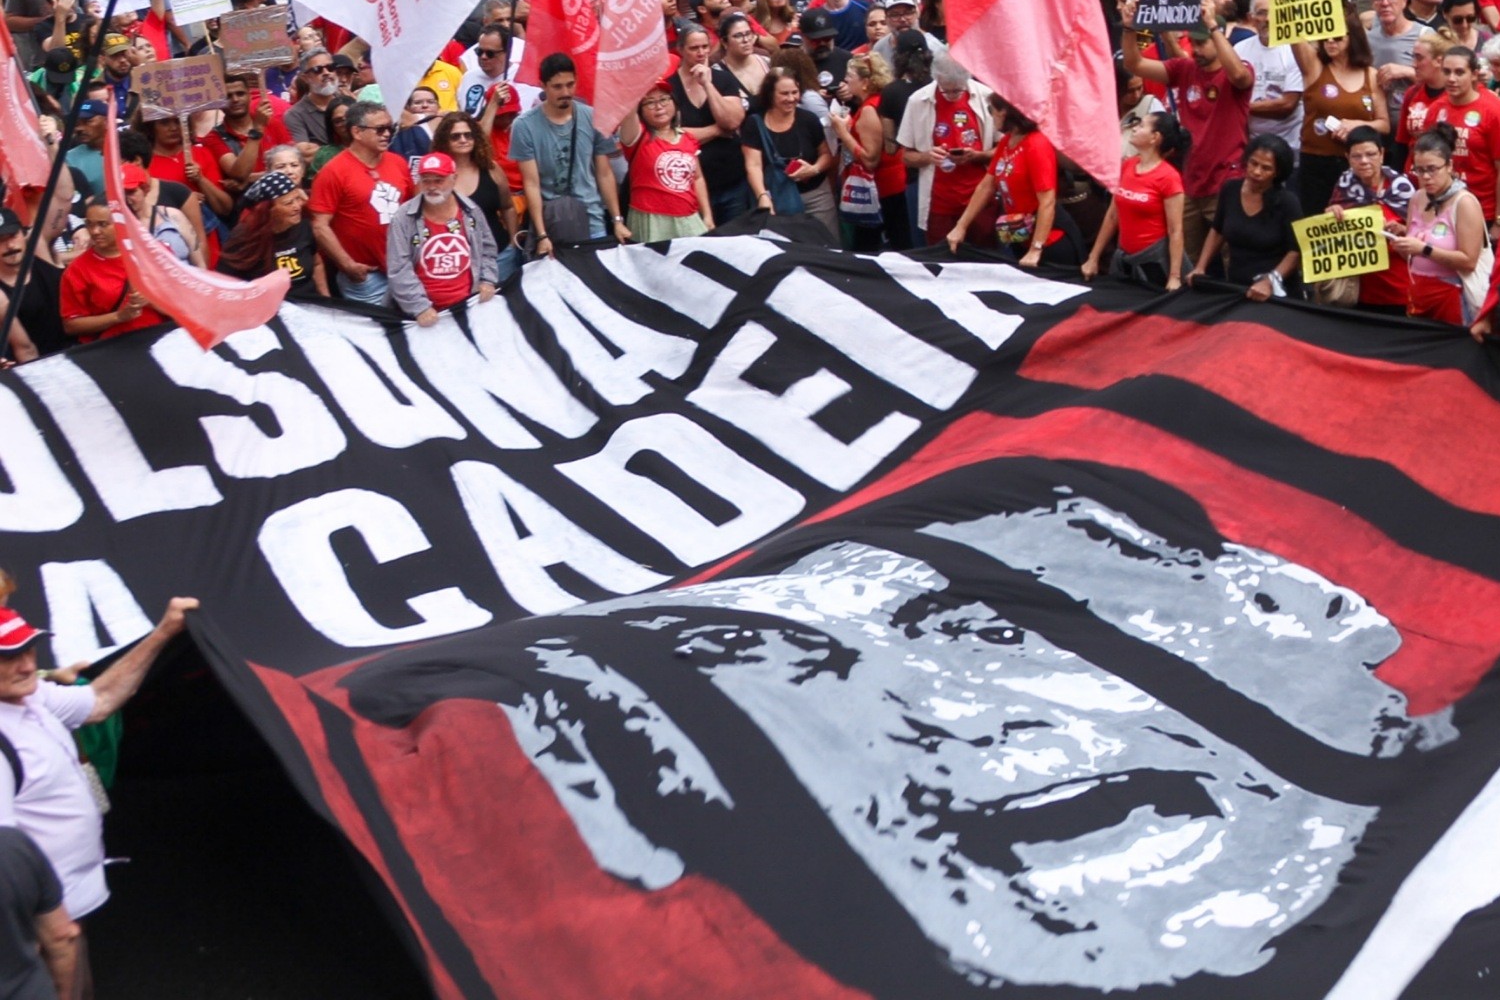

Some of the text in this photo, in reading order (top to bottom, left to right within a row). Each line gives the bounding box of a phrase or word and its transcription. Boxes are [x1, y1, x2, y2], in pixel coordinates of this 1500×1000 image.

[1274, 0, 1334, 26] INIMIGO
[1276, 17, 1336, 42] DO POVO
[1305, 216, 1374, 239] CONGRESSO
[1309, 230, 1378, 258] INIMIGO
[1312, 249, 1379, 275] DO POVO
[257, 242, 1096, 648] CADEIA
